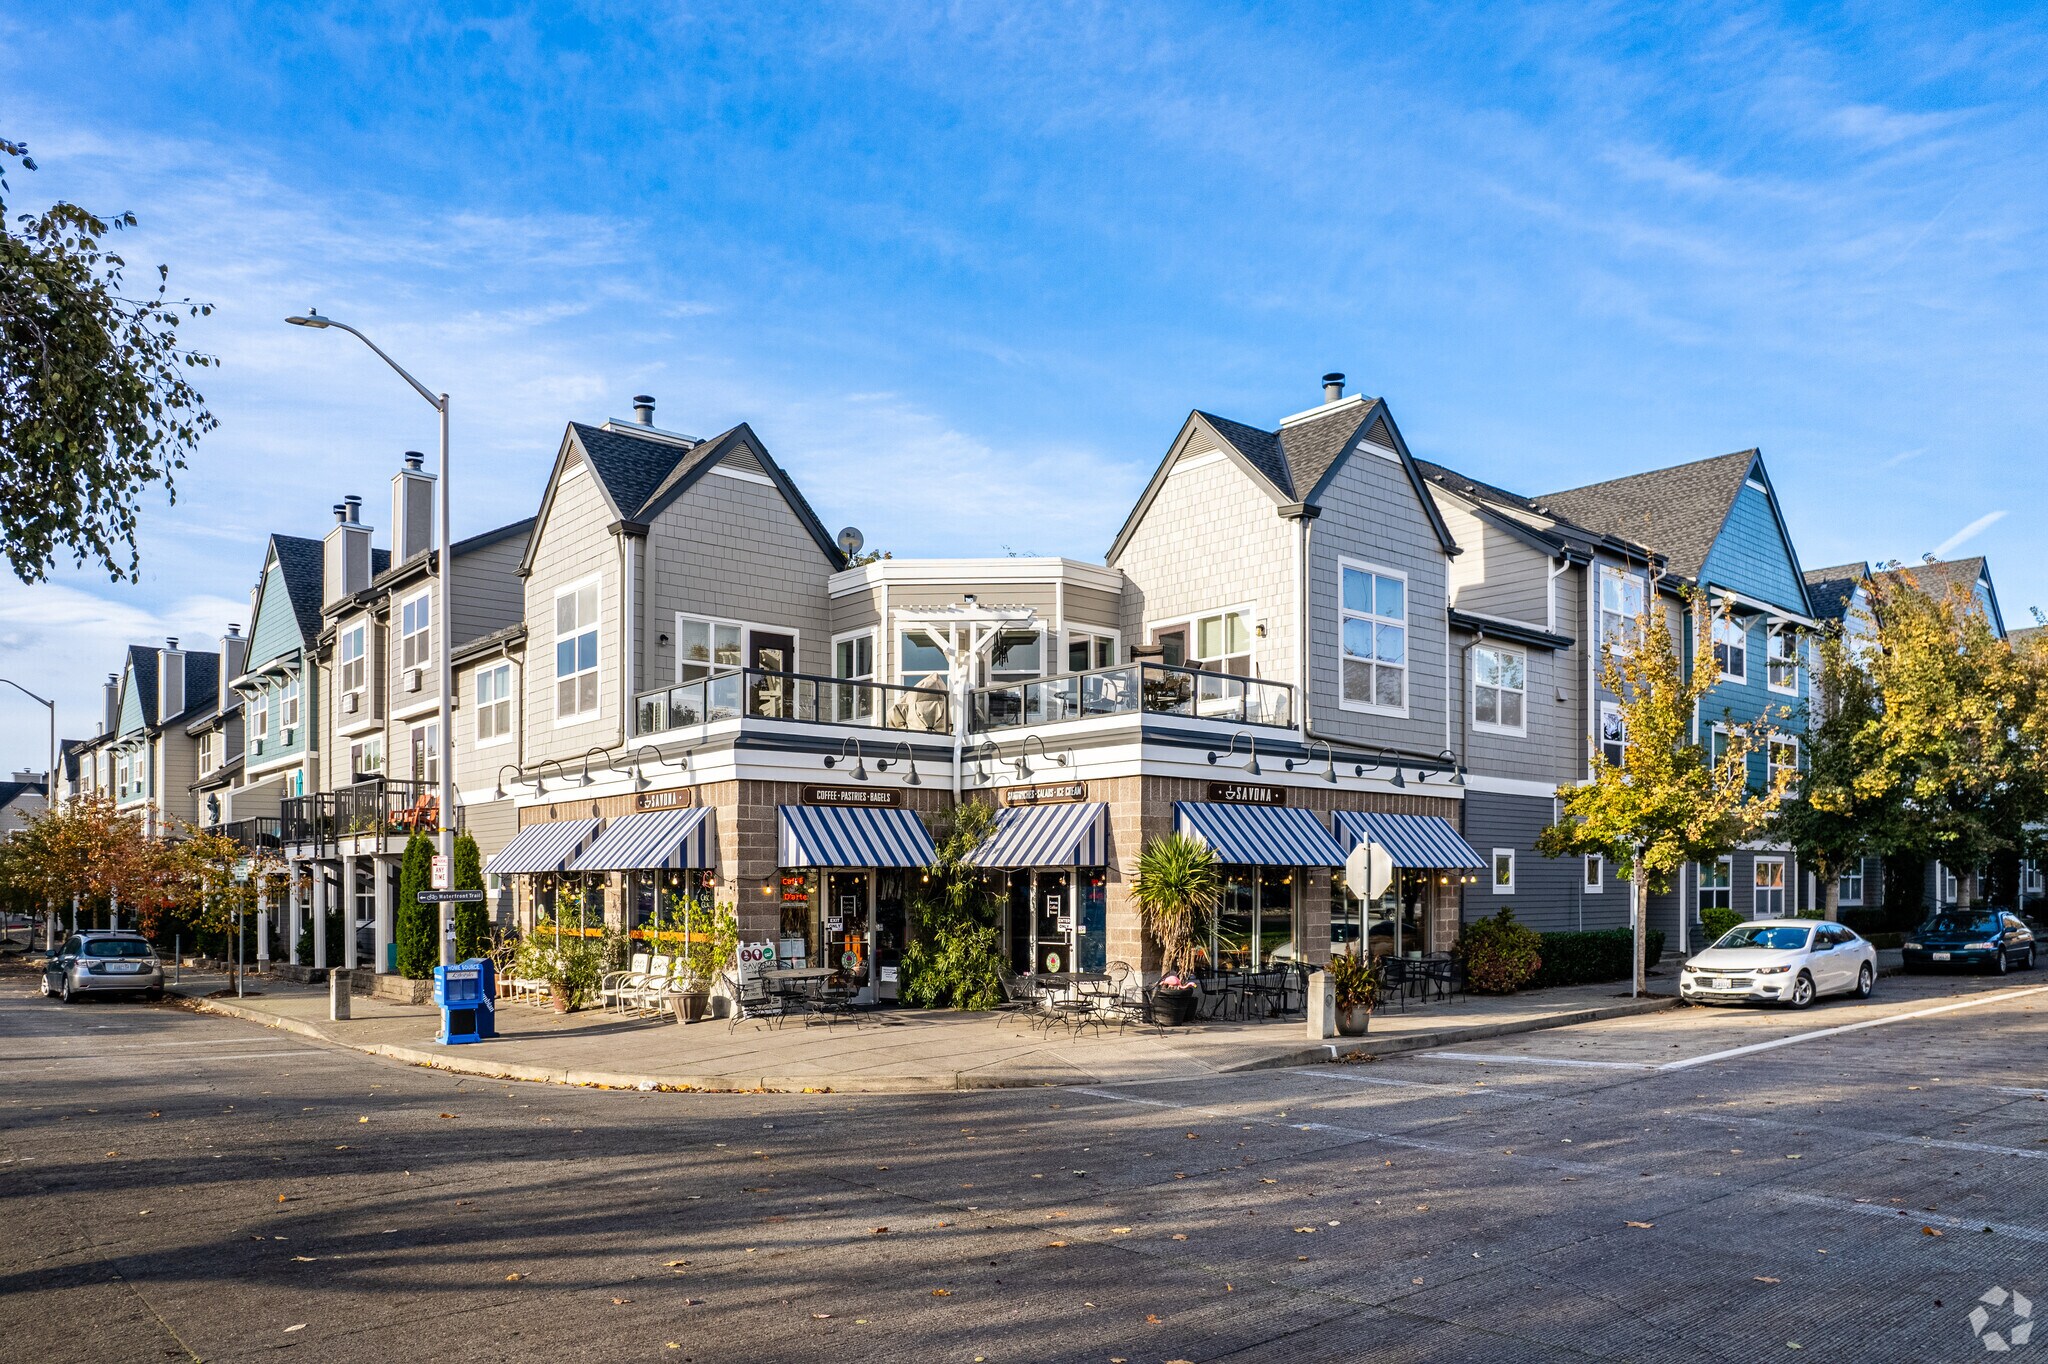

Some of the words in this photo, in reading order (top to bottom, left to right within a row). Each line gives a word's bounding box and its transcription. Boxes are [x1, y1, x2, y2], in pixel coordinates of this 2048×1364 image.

[816, 790, 837, 800] COFFEE
[840, 791, 867, 802] PASTRIES
[869, 792, 891, 803] BAGELS
[1036, 788, 1054, 798] SALADS
[1056, 787, 1065, 797] ICE
[1065, 785, 1082, 796] CREAM
[1236, 786, 1272, 802] SAVONA
[651, 792, 677, 808] SAVONA
